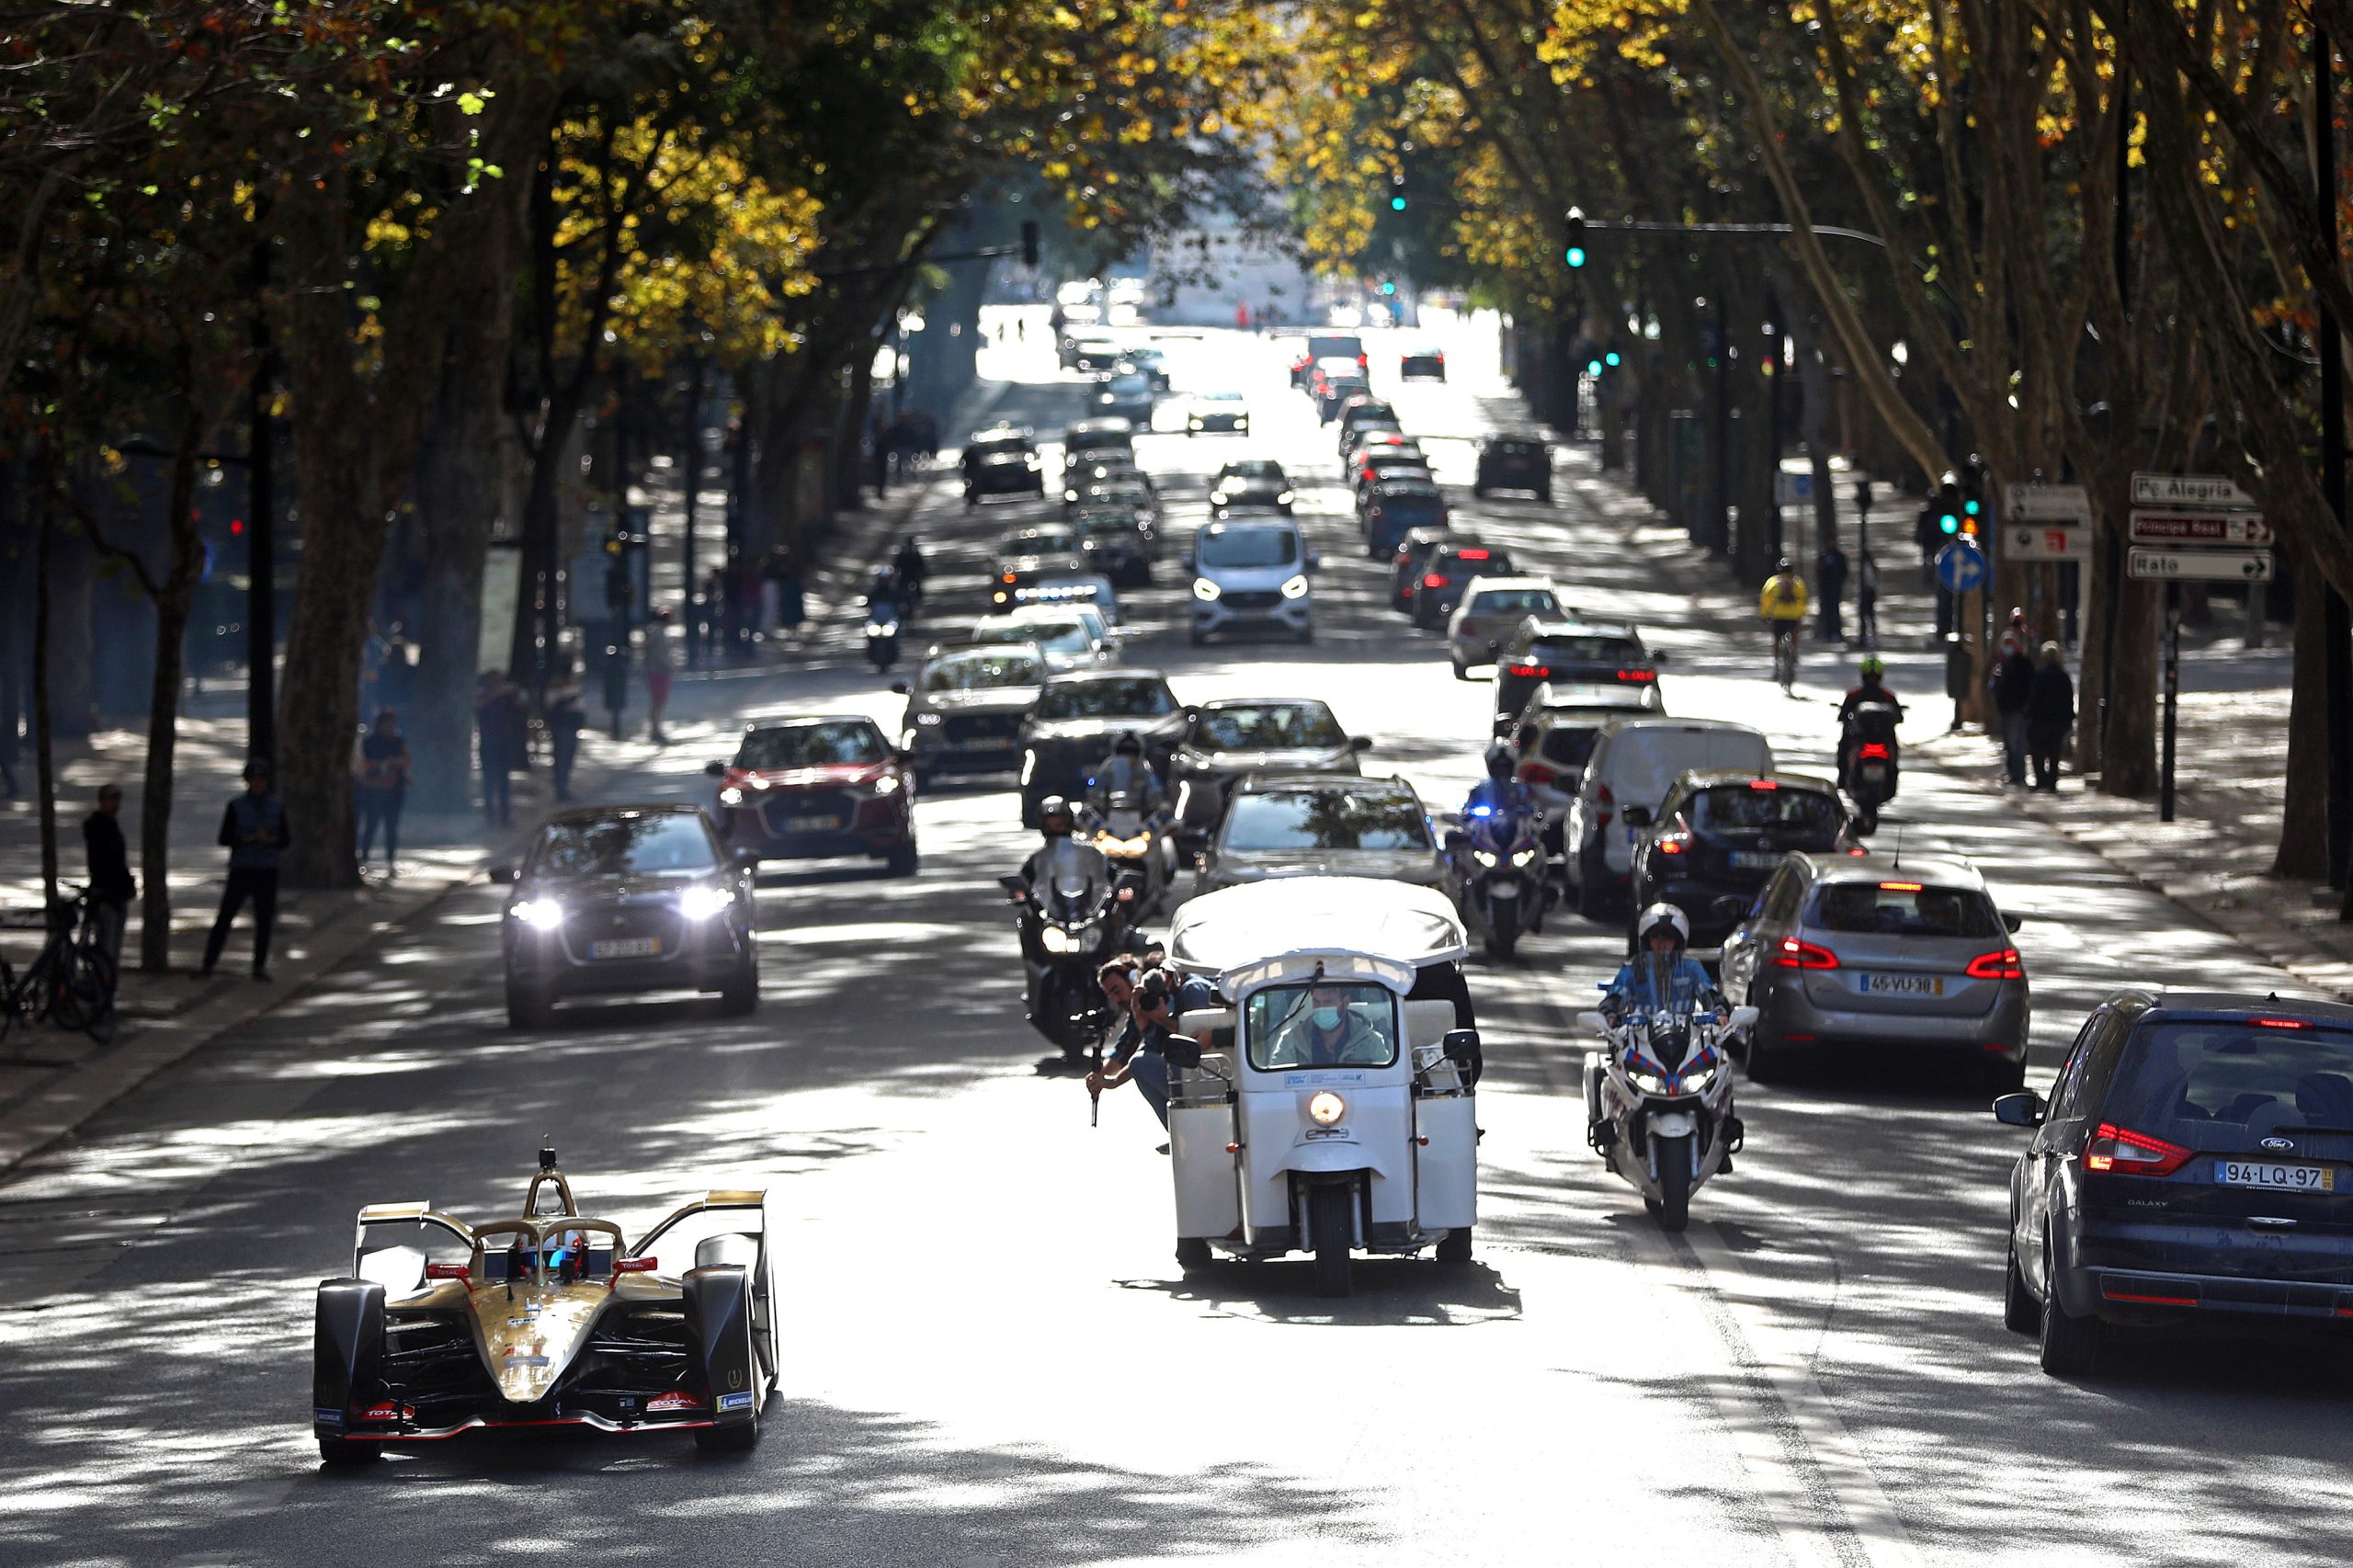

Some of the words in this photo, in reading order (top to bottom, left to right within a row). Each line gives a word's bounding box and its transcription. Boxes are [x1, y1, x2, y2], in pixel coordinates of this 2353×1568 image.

[2167, 479, 2233, 502] Alegria
[2137, 555, 2178, 571] Rato
[2267, 1139, 2287, 1148] Ford
[2127, 1199, 2168, 1207] GALAXY
[651, 1398, 698, 1406] TOTAL
